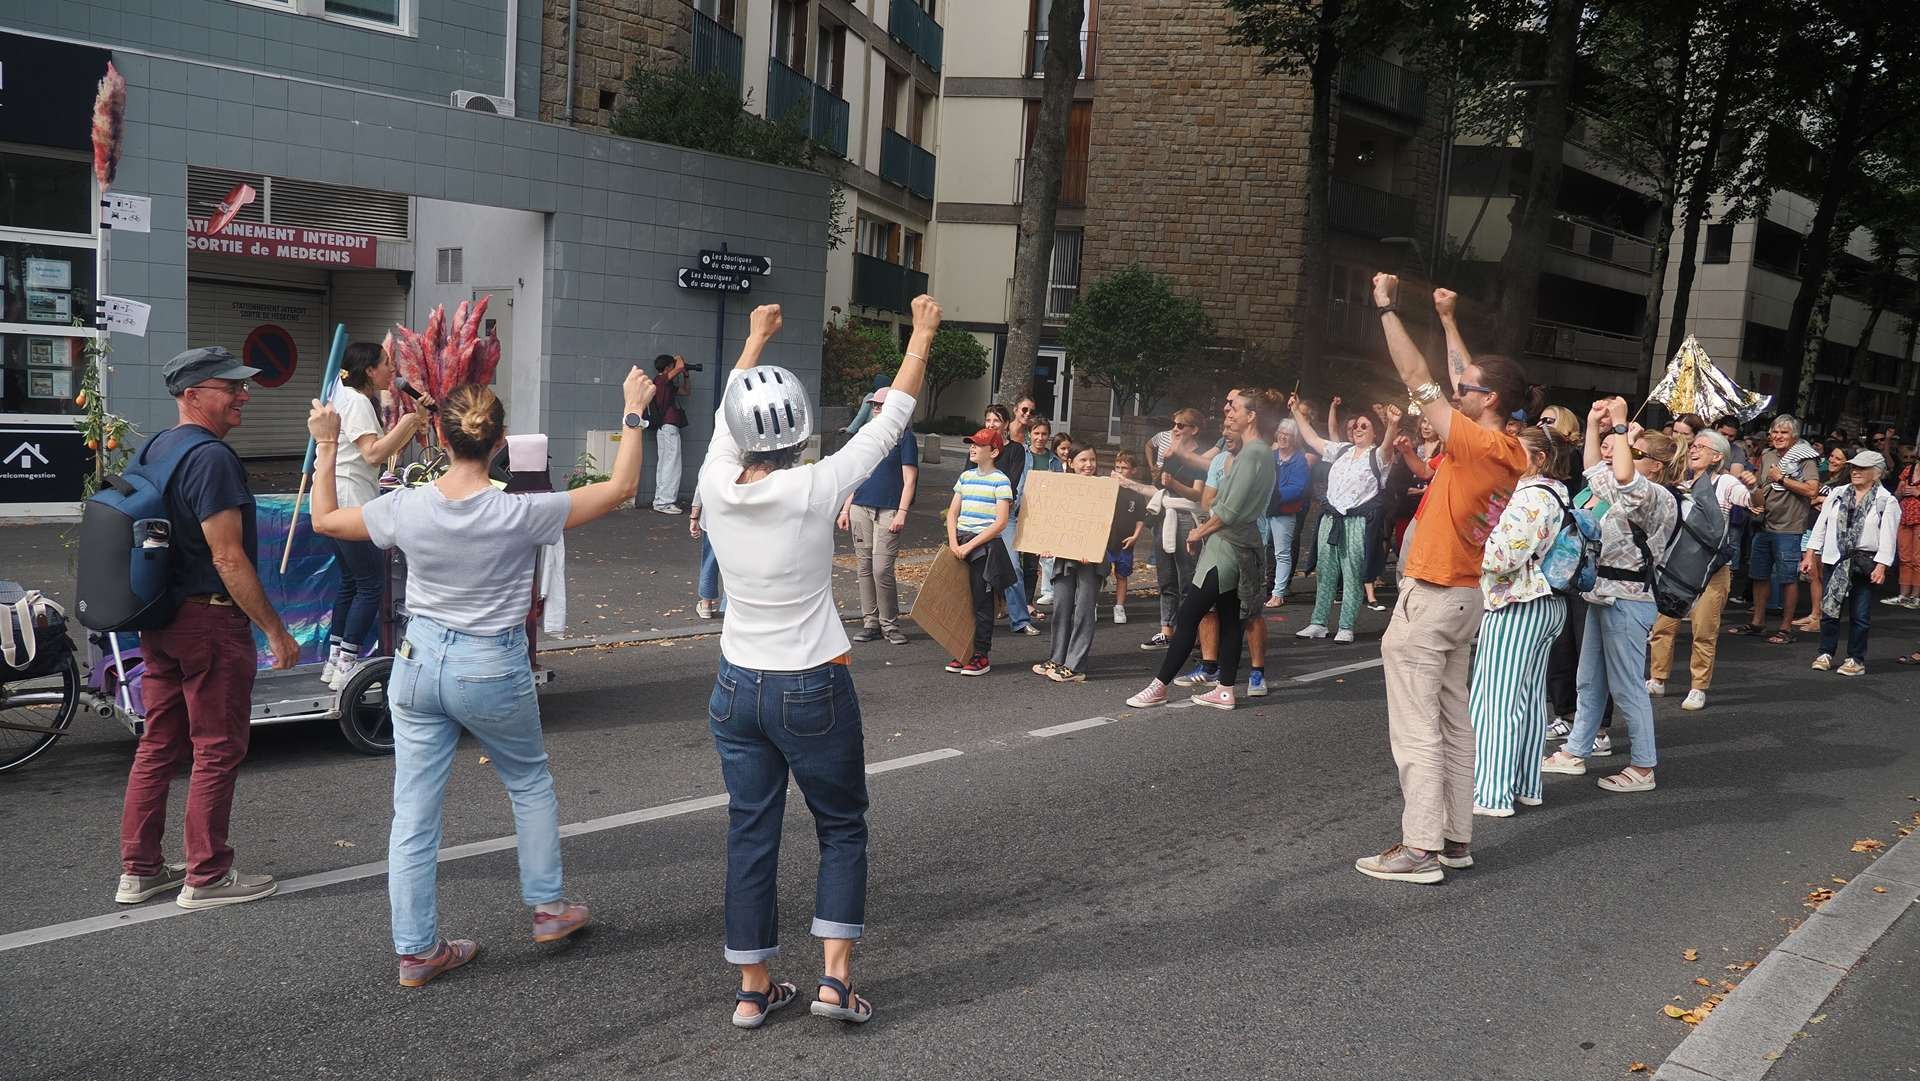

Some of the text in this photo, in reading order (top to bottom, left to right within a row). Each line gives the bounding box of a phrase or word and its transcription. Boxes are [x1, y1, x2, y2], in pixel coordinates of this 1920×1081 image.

[187, 219, 369, 249] ATINNEMENT INTERDIT
[187, 235, 350, 264] SORTIE de MEDECINS
[711, 252, 752, 264] Les boutiques
[711, 261, 719, 269] du
[738, 264, 746, 272] de
[747, 265, 760, 273] ville
[691, 271, 732, 282] Les boutiques
[727, 283, 740, 291] ville
